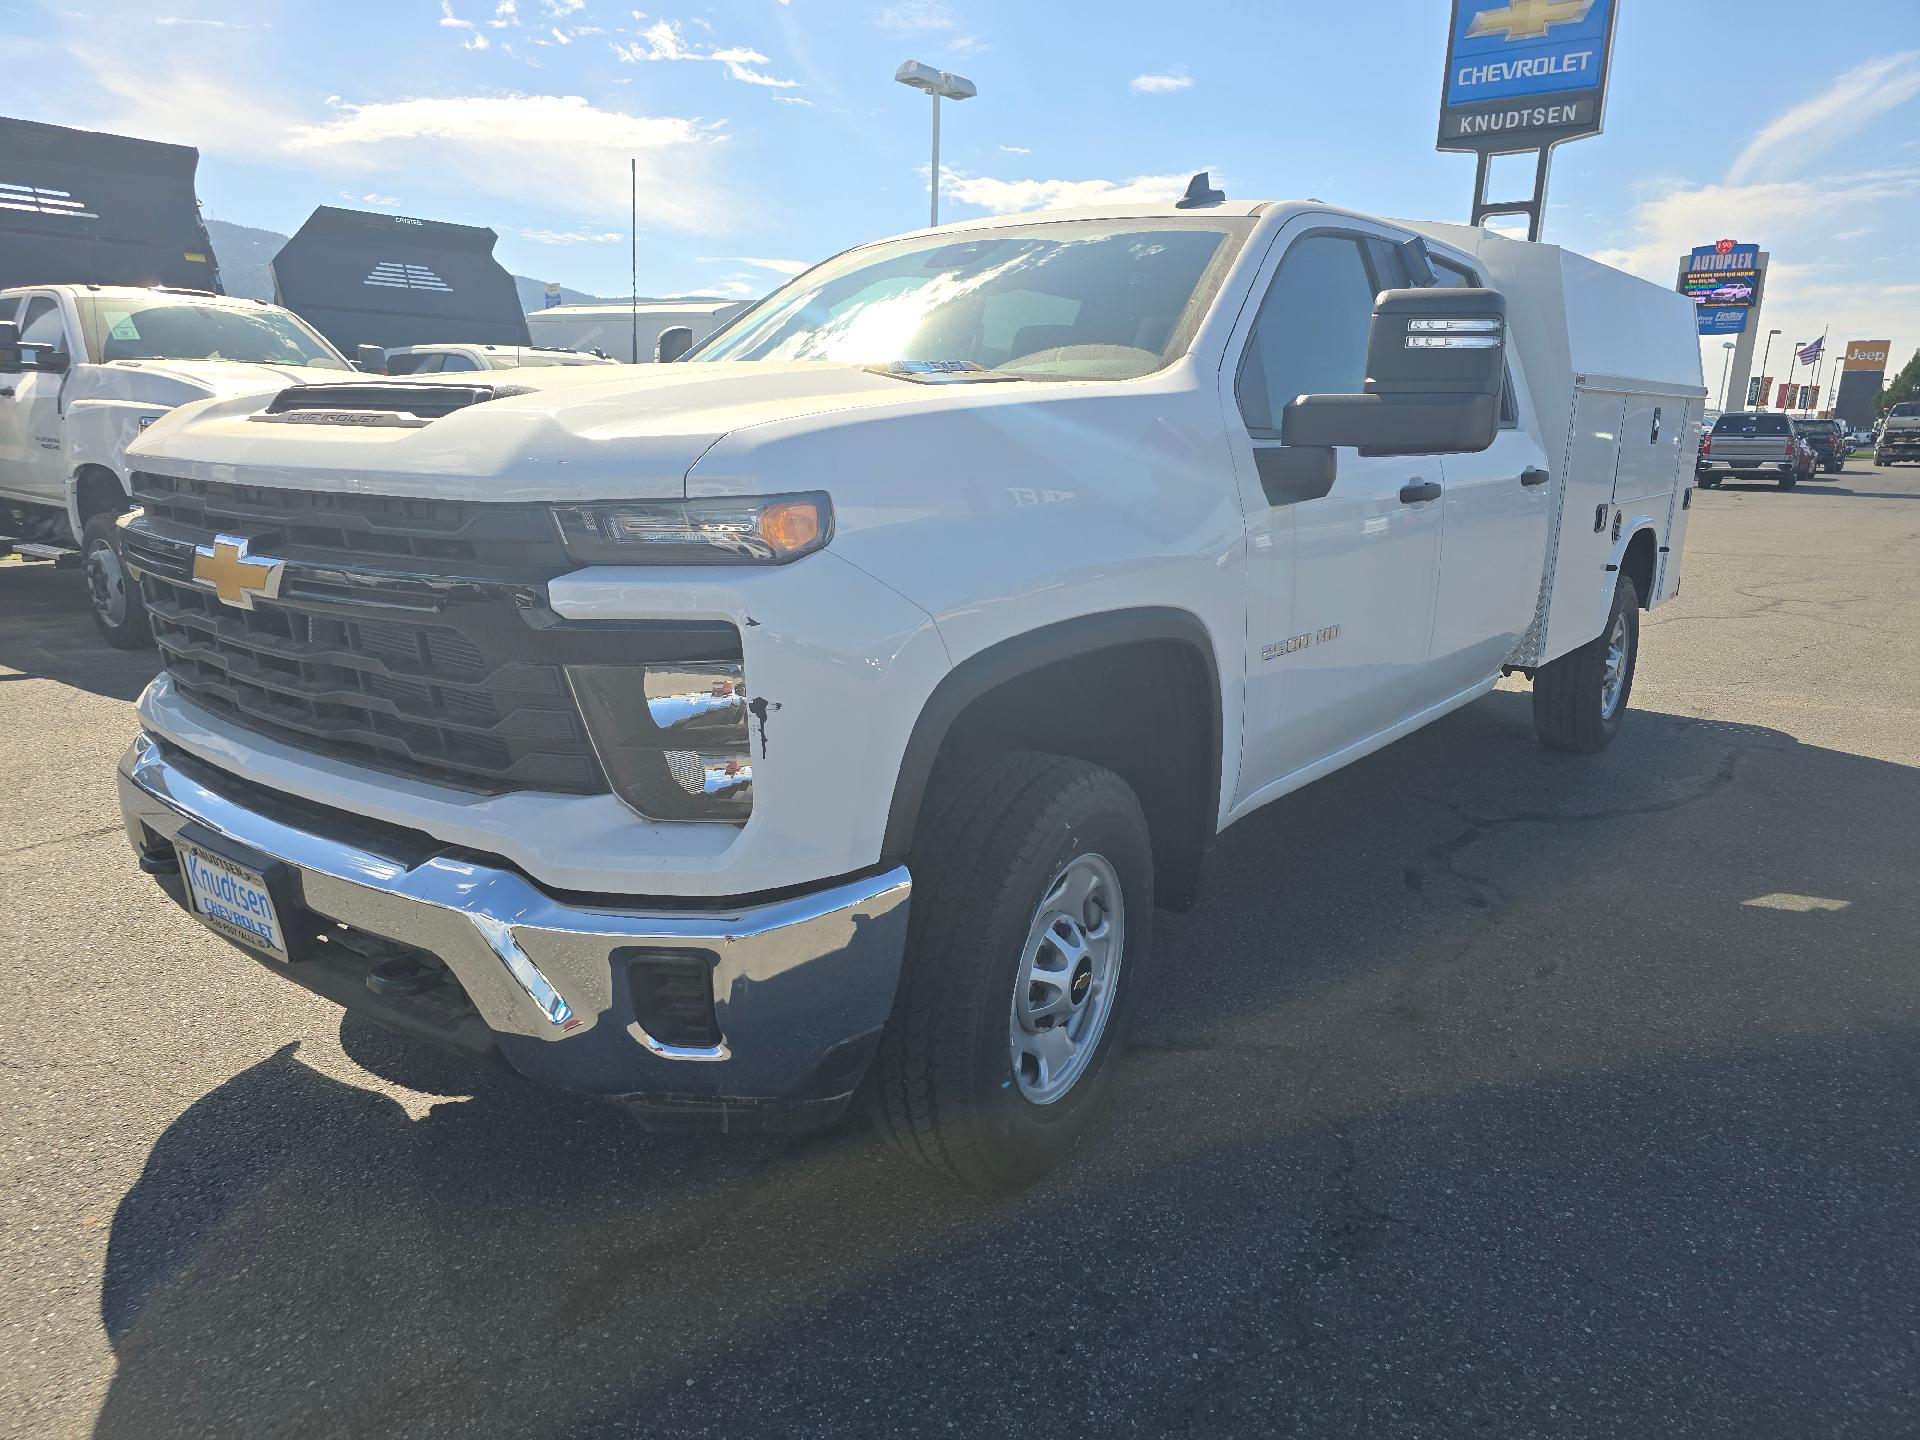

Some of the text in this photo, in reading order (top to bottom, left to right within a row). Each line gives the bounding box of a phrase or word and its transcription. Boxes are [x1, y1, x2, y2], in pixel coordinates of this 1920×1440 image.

[1458, 51, 1592, 86] CHEVROLET
[1460, 104, 1577, 134] KNUDTSEN
[1691, 253, 1753, 272] AUTOPLEX
[1848, 349, 1885, 361] Jeep
[288, 413, 384, 423] CHEVROLET
[1261, 623, 1342, 661] 2500 HD
[188, 854, 273, 920] Knudtsen
[204, 897, 273, 938] CHEVROLET
